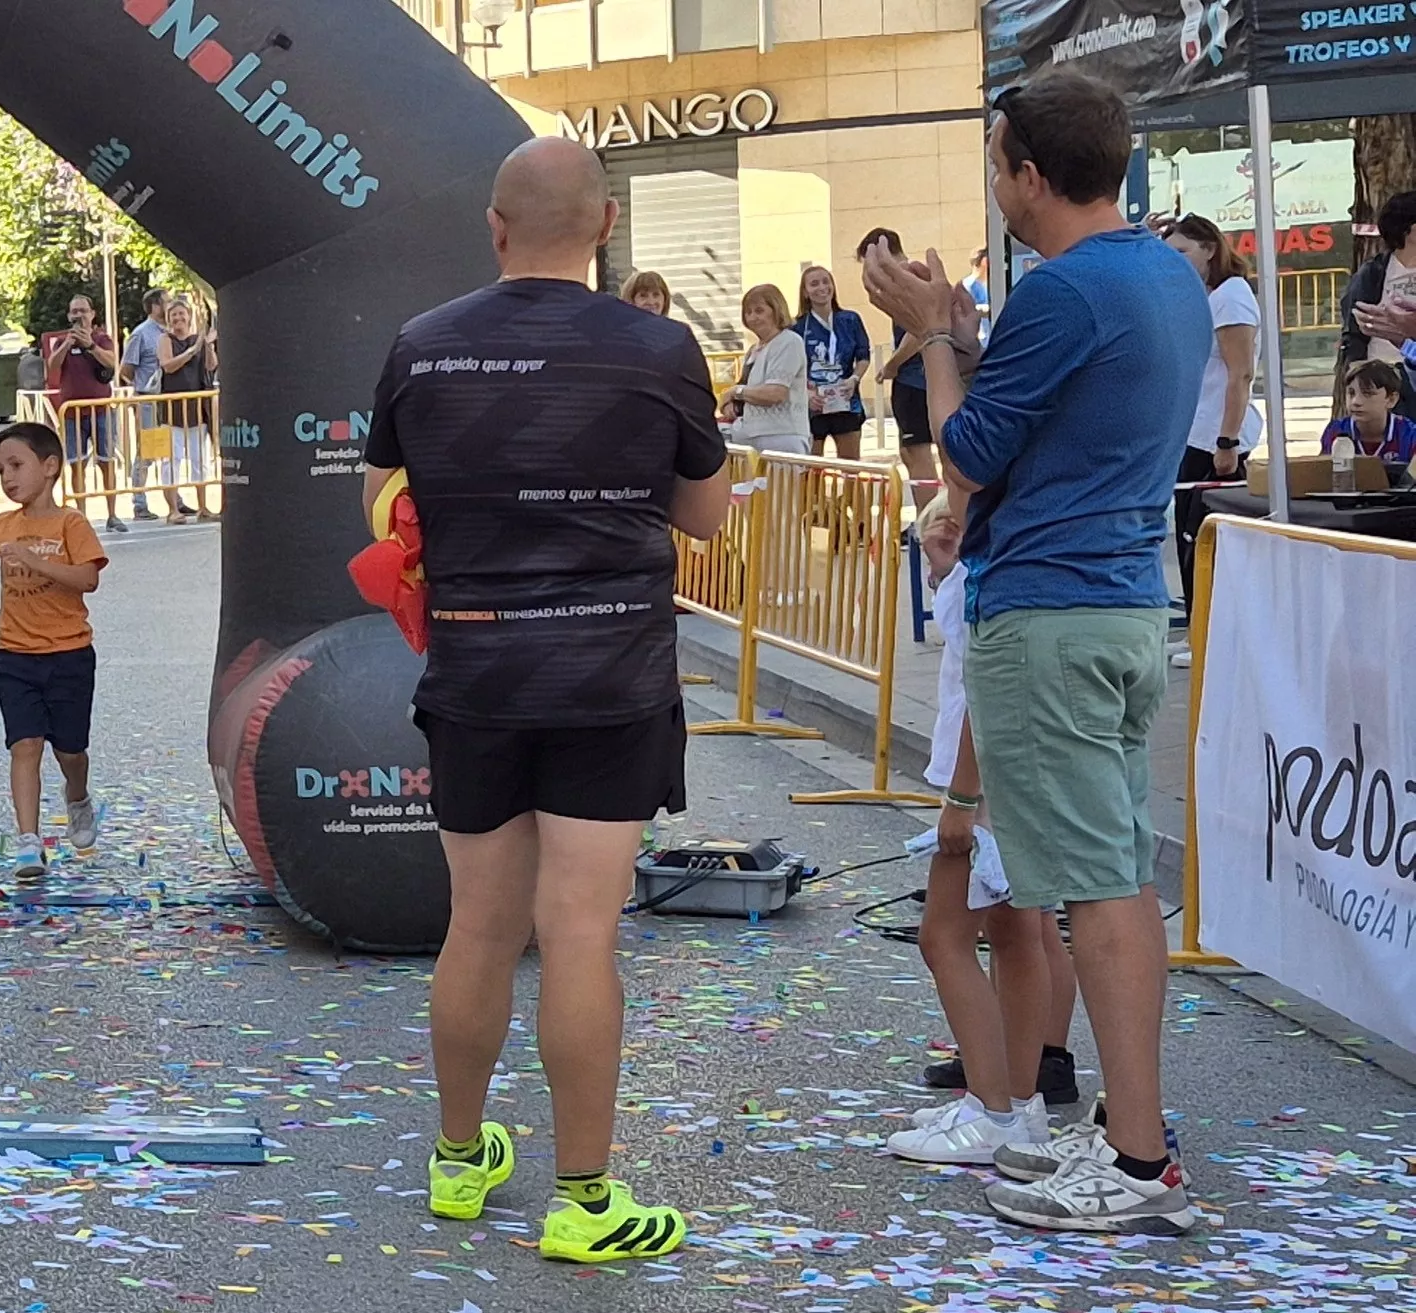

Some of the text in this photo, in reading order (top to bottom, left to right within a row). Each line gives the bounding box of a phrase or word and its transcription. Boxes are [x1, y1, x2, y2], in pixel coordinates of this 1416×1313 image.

[1301, 3, 1406, 31] SPEAKER
[1285, 34, 1411, 64] TROFEOS Y
[556, 88, 775, 150] MANGO
[435, 356, 480, 374] rápido
[482, 360, 510, 374] que
[512, 359, 547, 374] ayer
[518, 489, 566, 501] menos
[569, 489, 597, 502] que
[554, 603, 614, 617] ALFONSO
[350, 804, 403, 817] Servicio
[405, 803, 424, 815] de
[1295, 861, 1397, 944] PODOLOGÍA
